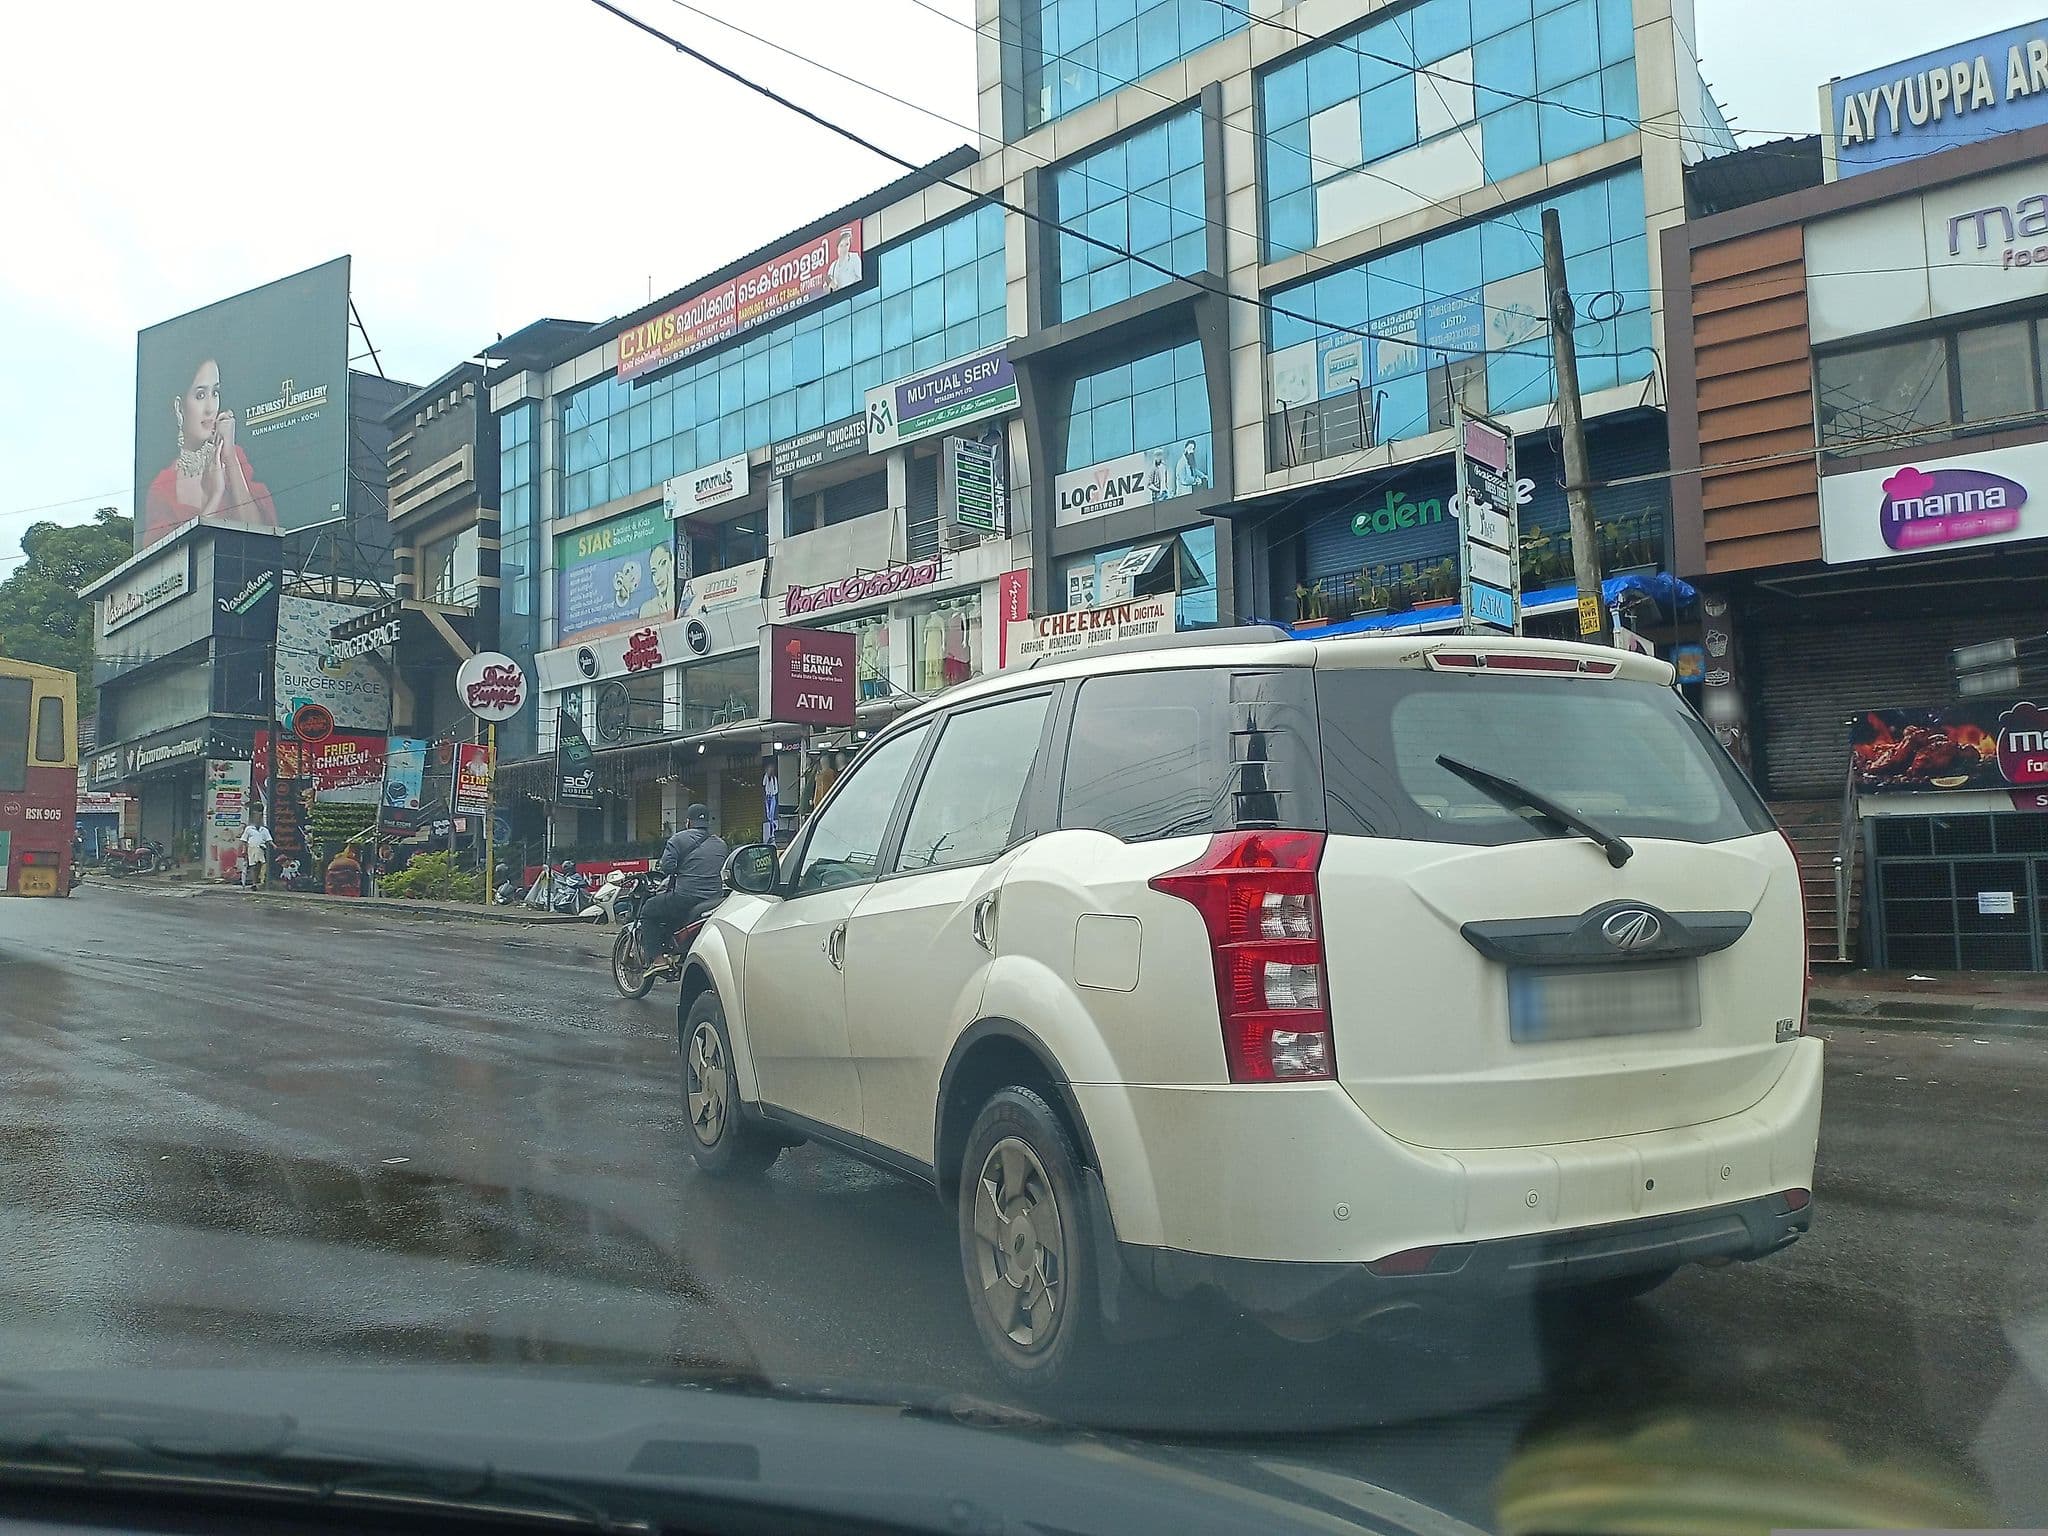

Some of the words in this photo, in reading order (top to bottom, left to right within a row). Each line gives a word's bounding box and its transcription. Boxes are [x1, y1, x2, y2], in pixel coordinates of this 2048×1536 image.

[1841, 55, 1995, 147] AYYUPPA
[620, 313, 675, 359] CIMS
[964, 358, 1000, 384] SERV
[289, 384, 328, 405] JEWELLERY
[826, 420, 866, 447] ADVOCATES
[1082, 499, 1123, 513] menswear
[1351, 490, 1442, 537] eden
[1891, 486, 2006, 521] manna
[578, 528, 612, 557] STAR
[1039, 604, 1132, 637] CHEERAN
[1134, 604, 1165, 621] DIGITAL
[1020, 639, 1045, 654] EARPHONE
[1087, 628, 1112, 645] PENDRIVE
[802, 653, 843, 667] KERALA
[802, 663, 833, 675] BANK
[796, 693, 833, 711] ATM
[316, 749, 369, 770] CHICKEN!
[324, 742, 356, 757] FRIED
[563, 787, 594, 796] MOBILES
[44, 808, 62, 820] 905
